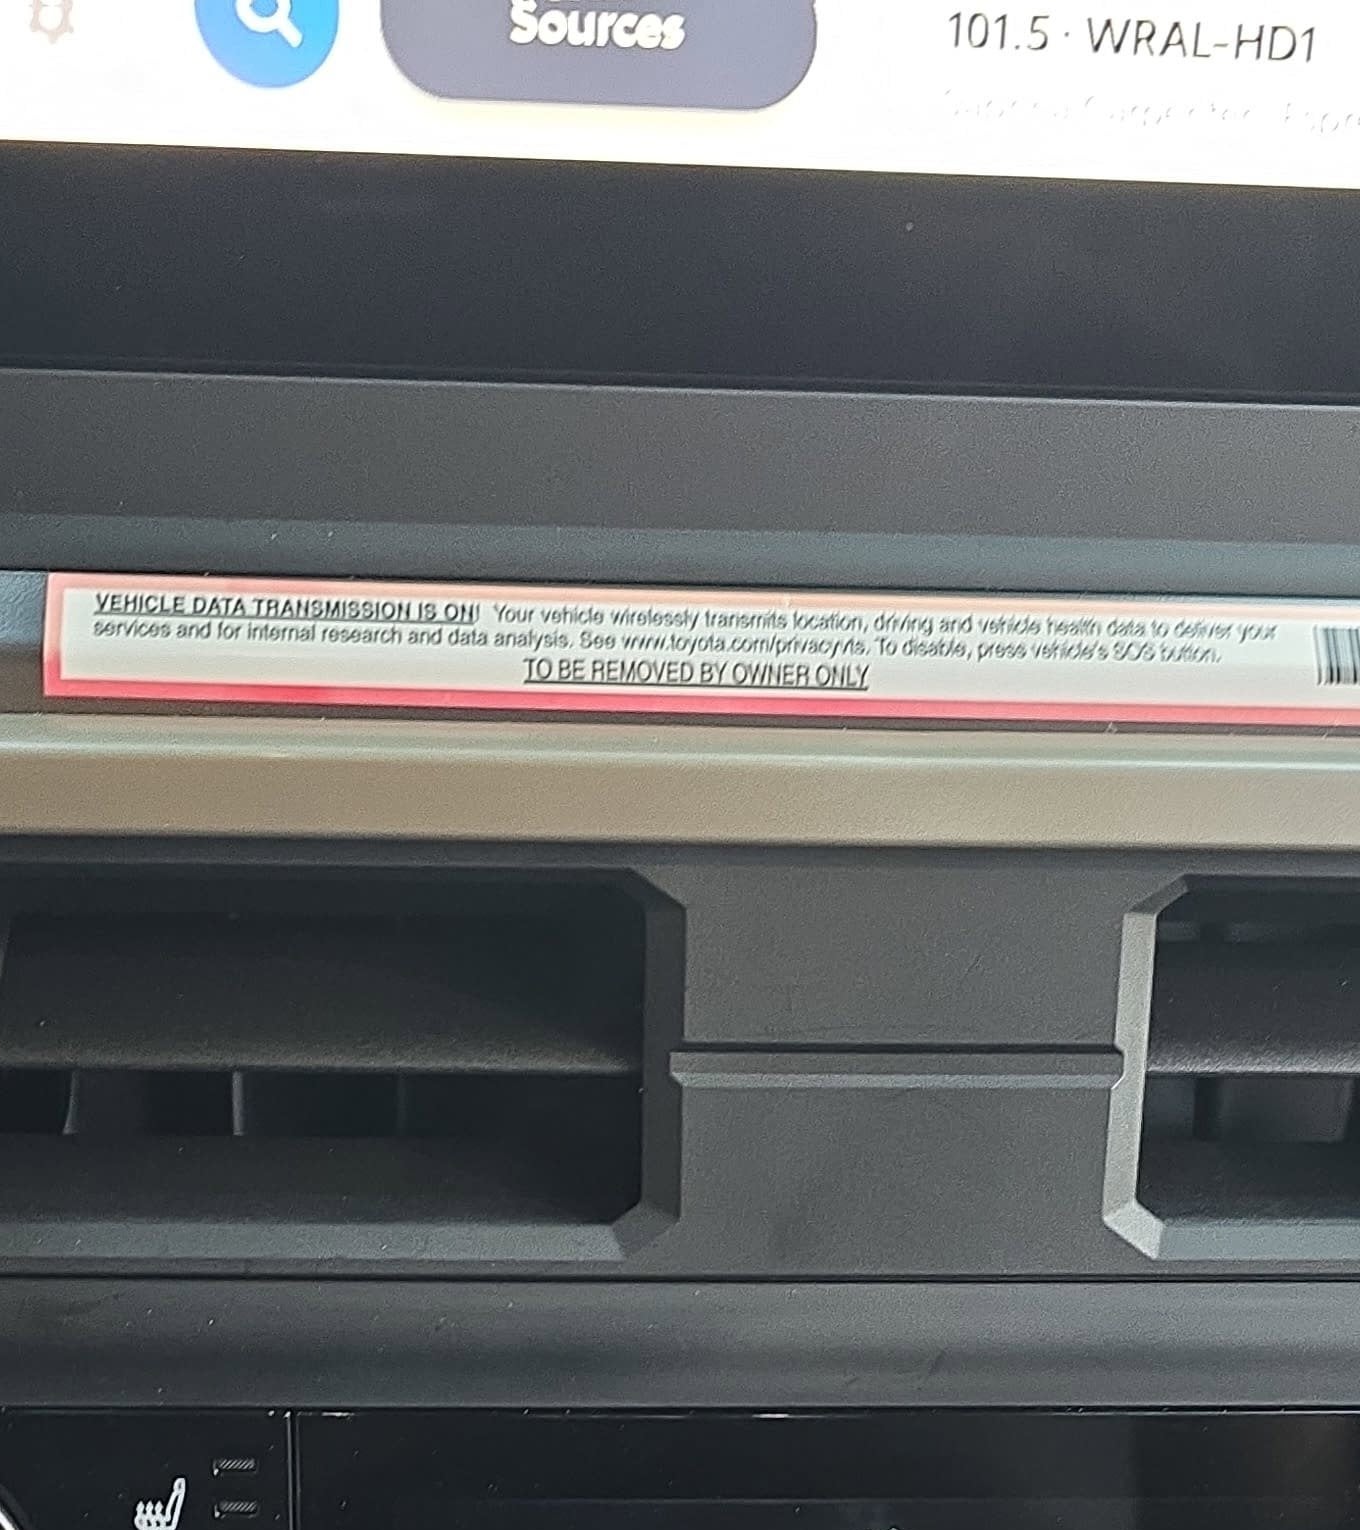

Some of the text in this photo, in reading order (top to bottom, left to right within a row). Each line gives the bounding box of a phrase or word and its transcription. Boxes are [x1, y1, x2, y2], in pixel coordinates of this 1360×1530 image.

[509, 6, 686, 50] Sources
[947, 11, 1317, 63] 101.5 WRAL-HD1
[94, 618, 171, 638] services
[176, 620, 211, 639] and
[217, 620, 242, 640] for
[247, 622, 316, 641] internal
[321, 625, 402, 645] research
[408, 627, 442, 645] and
[448, 628, 488, 646] data
[493, 630, 573, 652] analysis.
[579, 631, 616, 649] See
[874, 636, 897, 656] To
[978, 641, 1027, 662] press
[95, 593, 185, 614] VEHICLE
[192, 597, 247, 616] DATA
[253, 597, 410, 620] TRANSMISSION
[417, 603, 436, 621] IS
[493, 604, 535, 623] Your
[541, 606, 604, 625] vehicle
[611, 606, 699, 630] wirelessly
[704, 609, 787, 629] transmits
[793, 610, 868, 633] location,
[873, 612, 933, 636] driving
[939, 613, 974, 633] and
[978, 614, 1040, 635] vehicle
[1045, 615, 1100, 637] health
[1106, 617, 1145, 638] data
[1151, 618, 1169, 638] to
[1238, 622, 1278, 644] your
[524, 657, 871, 688] TO BE REMOVED BY OWNER ONLY
